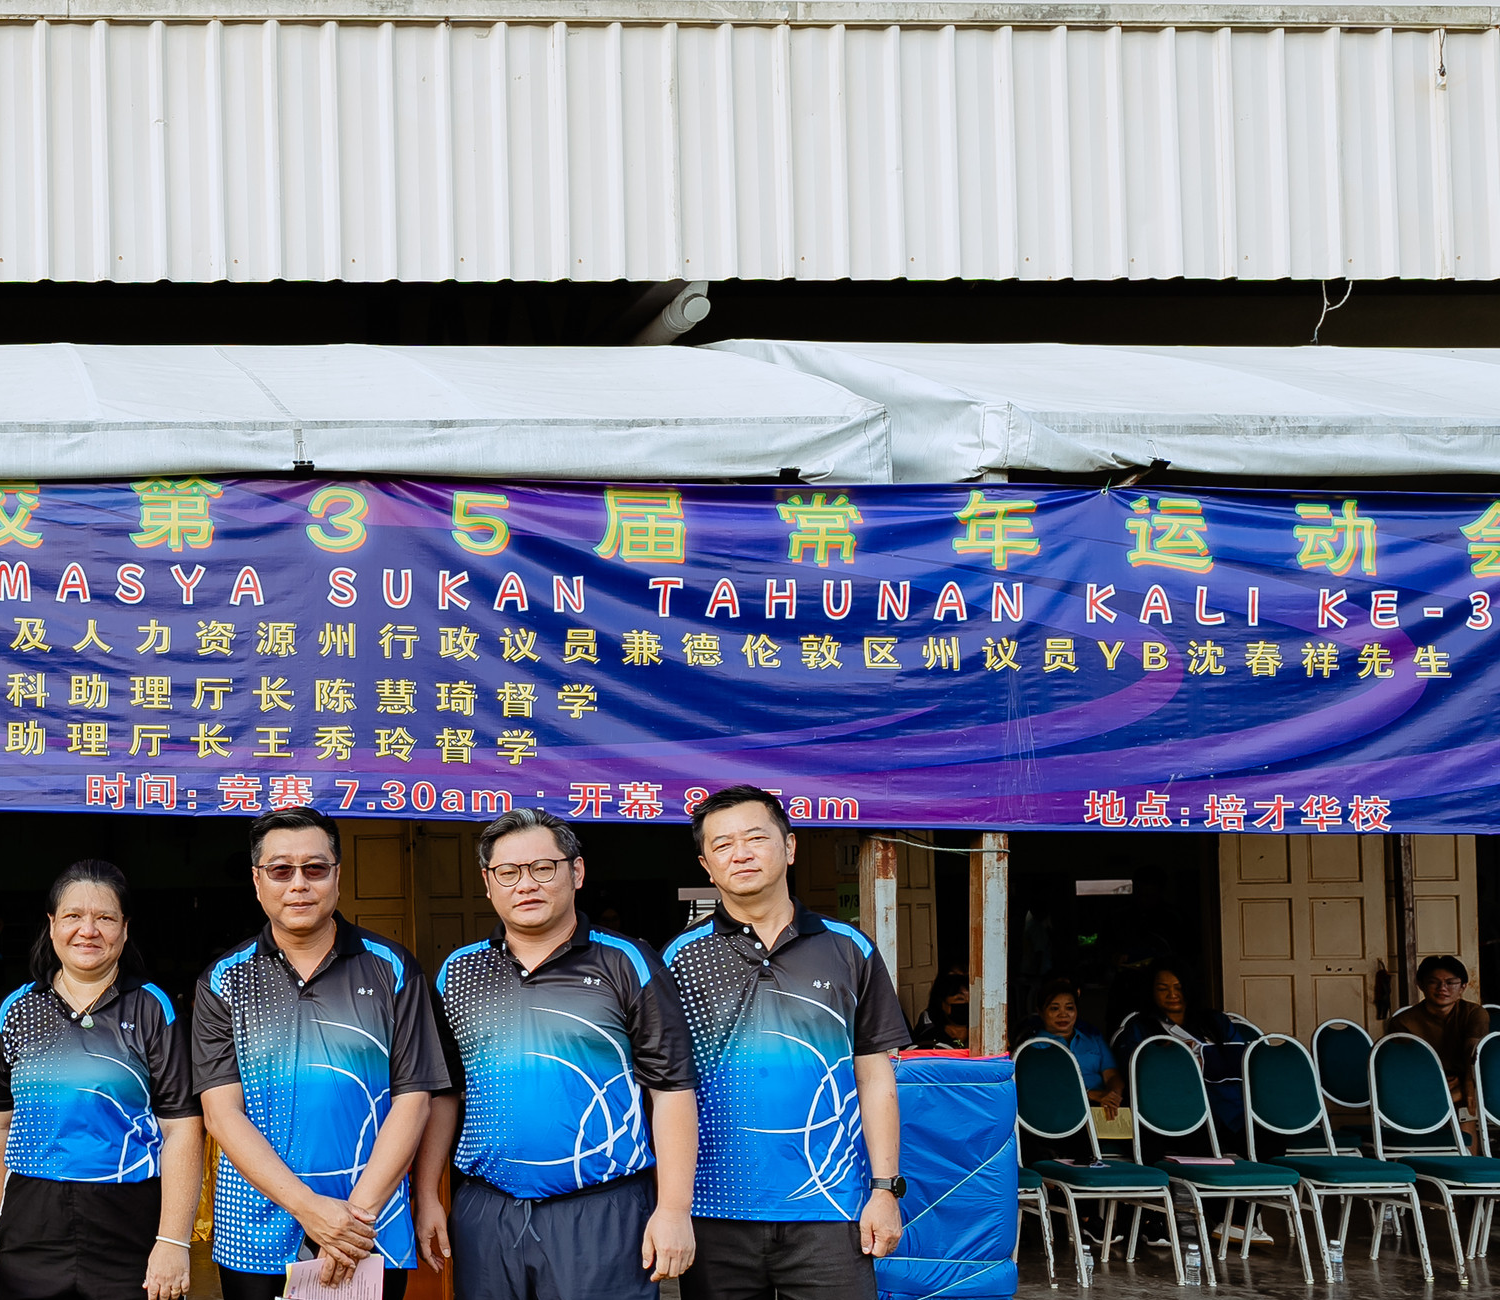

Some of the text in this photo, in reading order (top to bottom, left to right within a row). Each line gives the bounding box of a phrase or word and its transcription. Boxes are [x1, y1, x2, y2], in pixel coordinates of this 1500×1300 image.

[326, 567, 587, 614] SUKAN
[648, 576, 1024, 622] TAHUNAN
[1085, 582, 1260, 627] KALI
